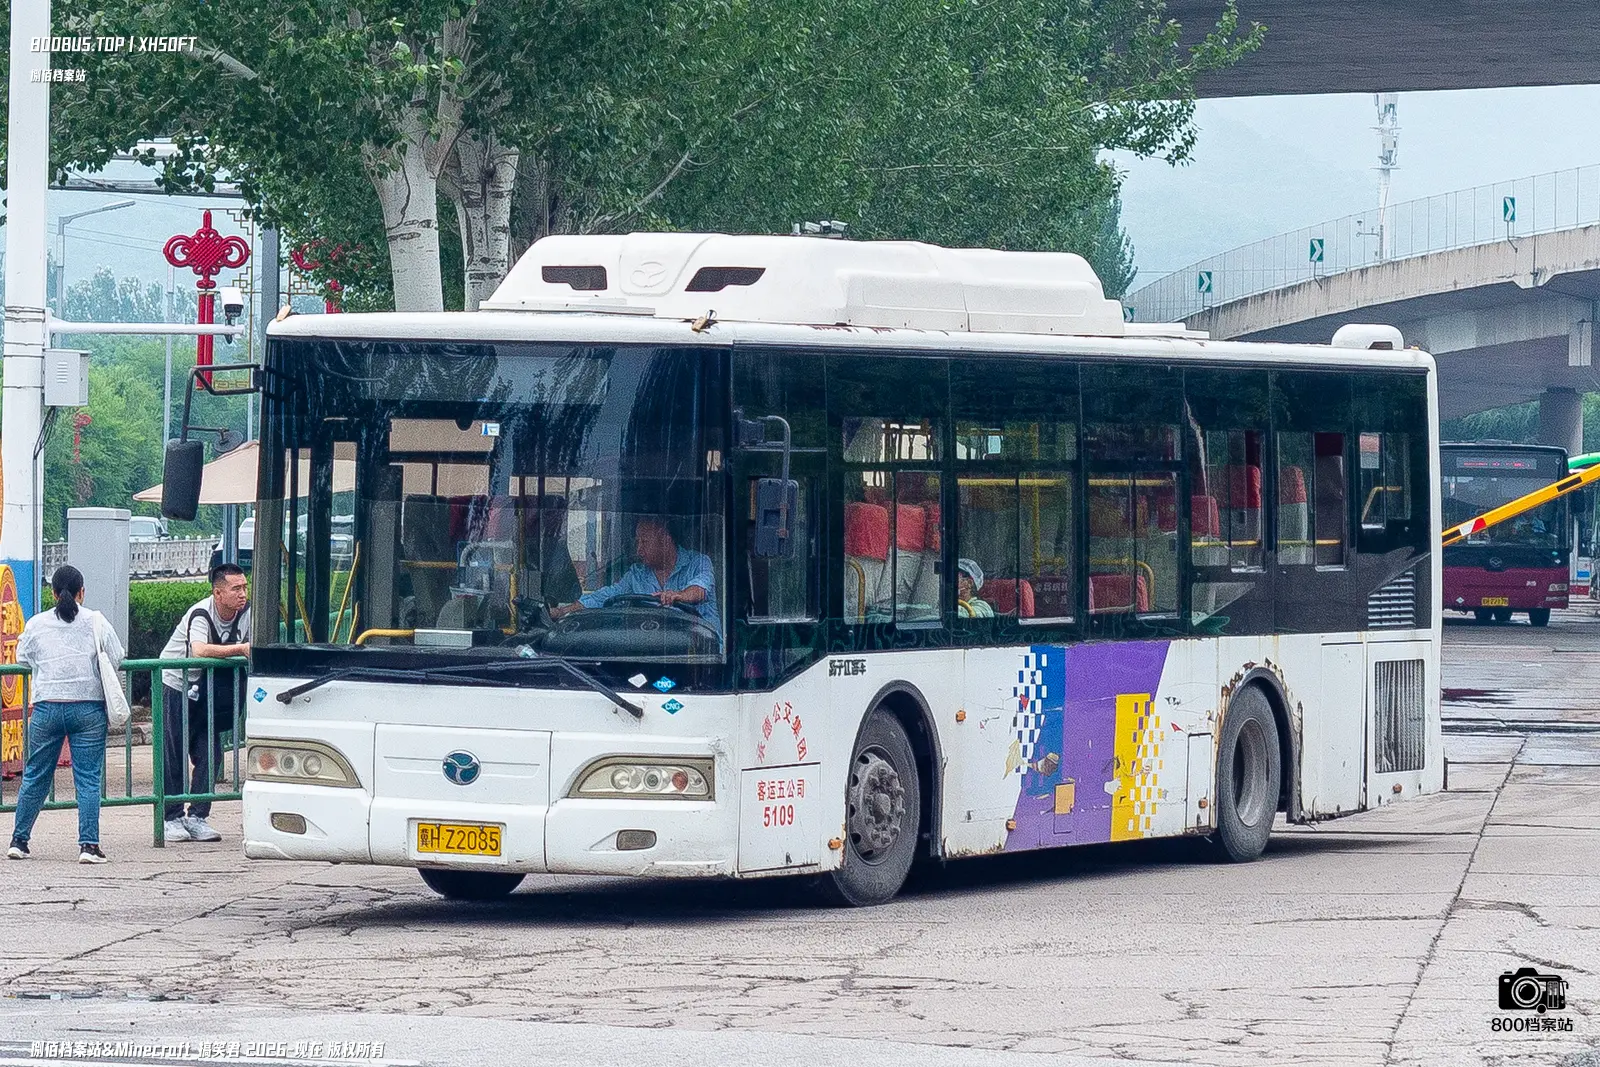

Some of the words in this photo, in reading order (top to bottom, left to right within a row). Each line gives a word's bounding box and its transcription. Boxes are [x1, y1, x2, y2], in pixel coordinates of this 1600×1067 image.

[656, 679, 672, 689] CNG
[664, 702, 681, 711] CNG
[757, 778, 806, 802] 客运五公司
[763, 804, 795, 828] 5109
